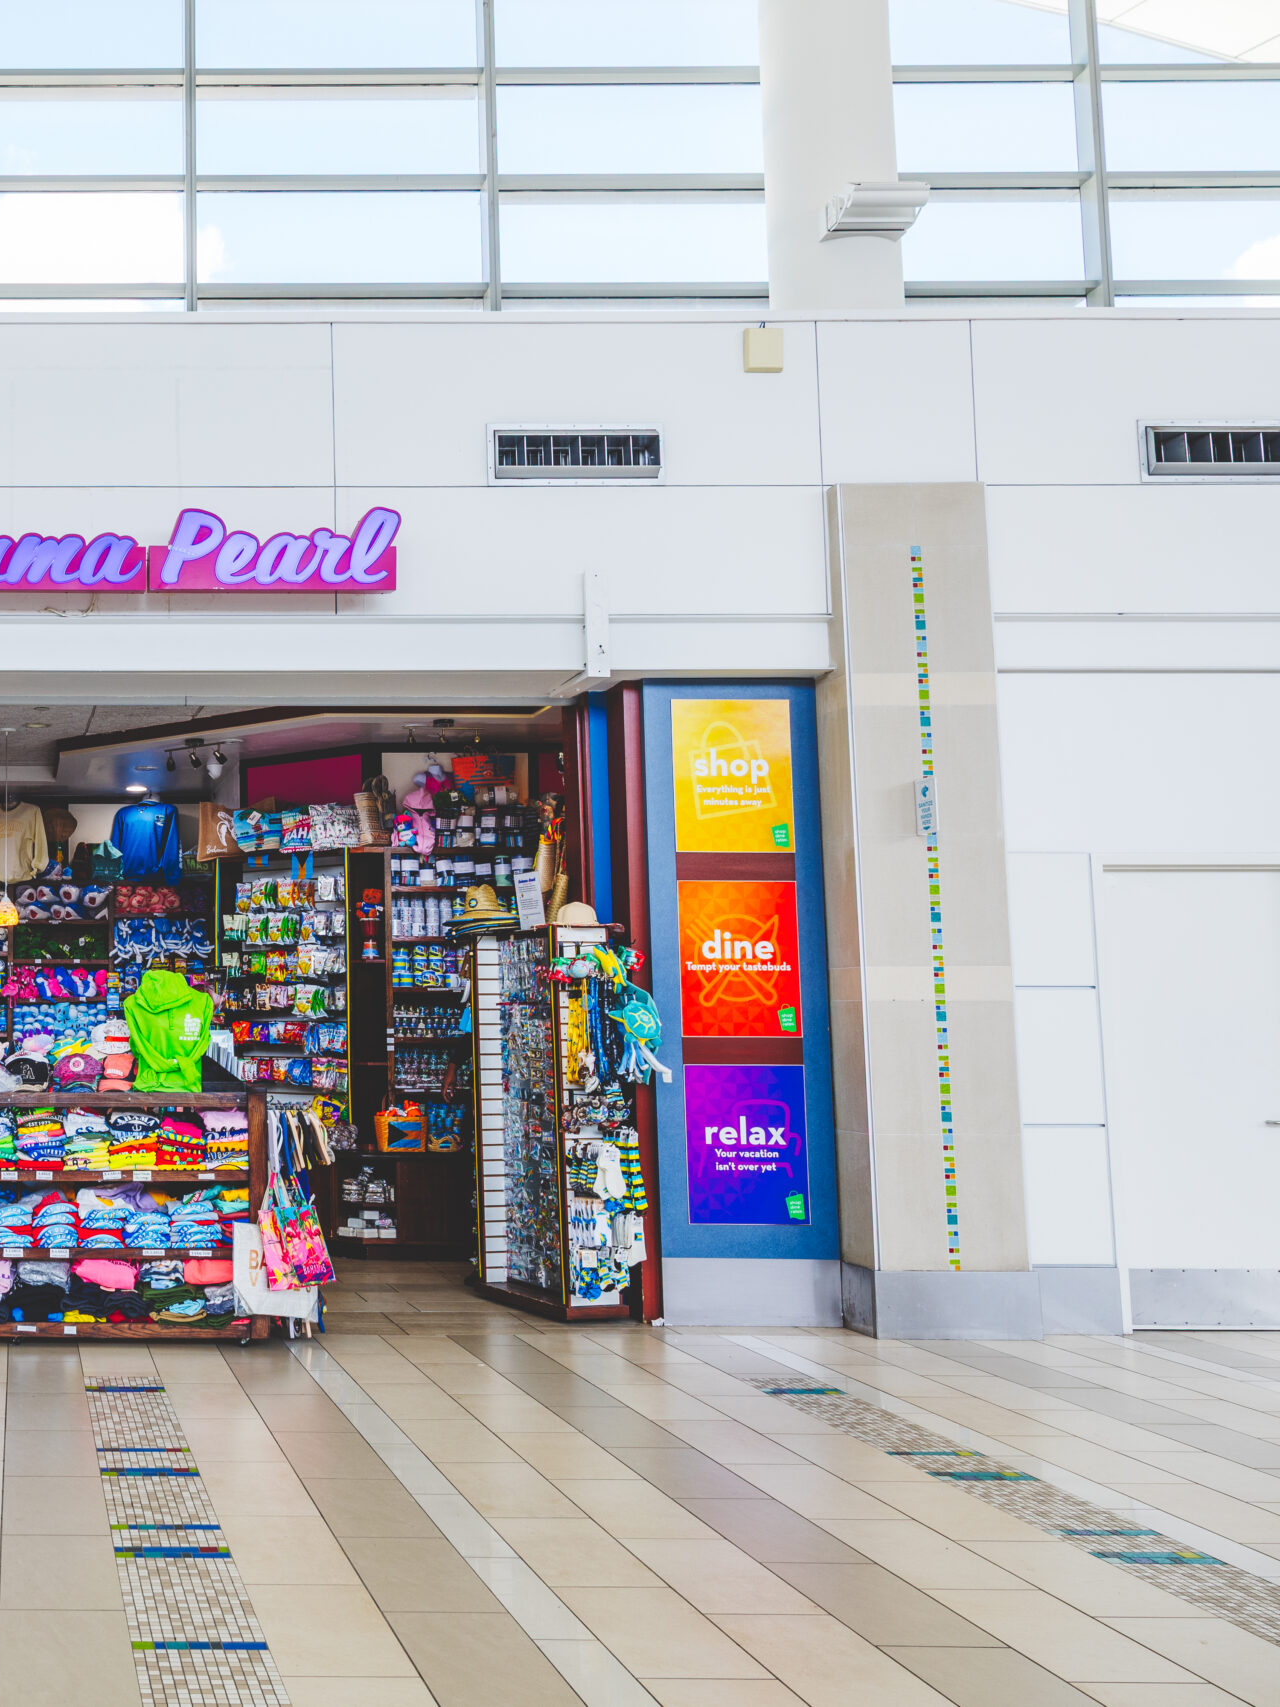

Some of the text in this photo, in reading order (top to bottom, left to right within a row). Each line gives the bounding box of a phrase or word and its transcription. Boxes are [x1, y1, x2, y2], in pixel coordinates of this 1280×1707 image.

[160, 507, 401, 584] Pearl
[694, 748, 769, 784] shop
[696, 785, 771, 795] Everything is just
[703, 797, 762, 808] minutes away
[702, 929, 774, 959] dine
[685, 961, 792, 973] Tempt your tastebuds
[704, 1115, 787, 1146] relax
[715, 1149, 779, 1158] Your vacation
[715, 1162, 736, 1171] isn't
[760, 1163, 777, 1173] yet
